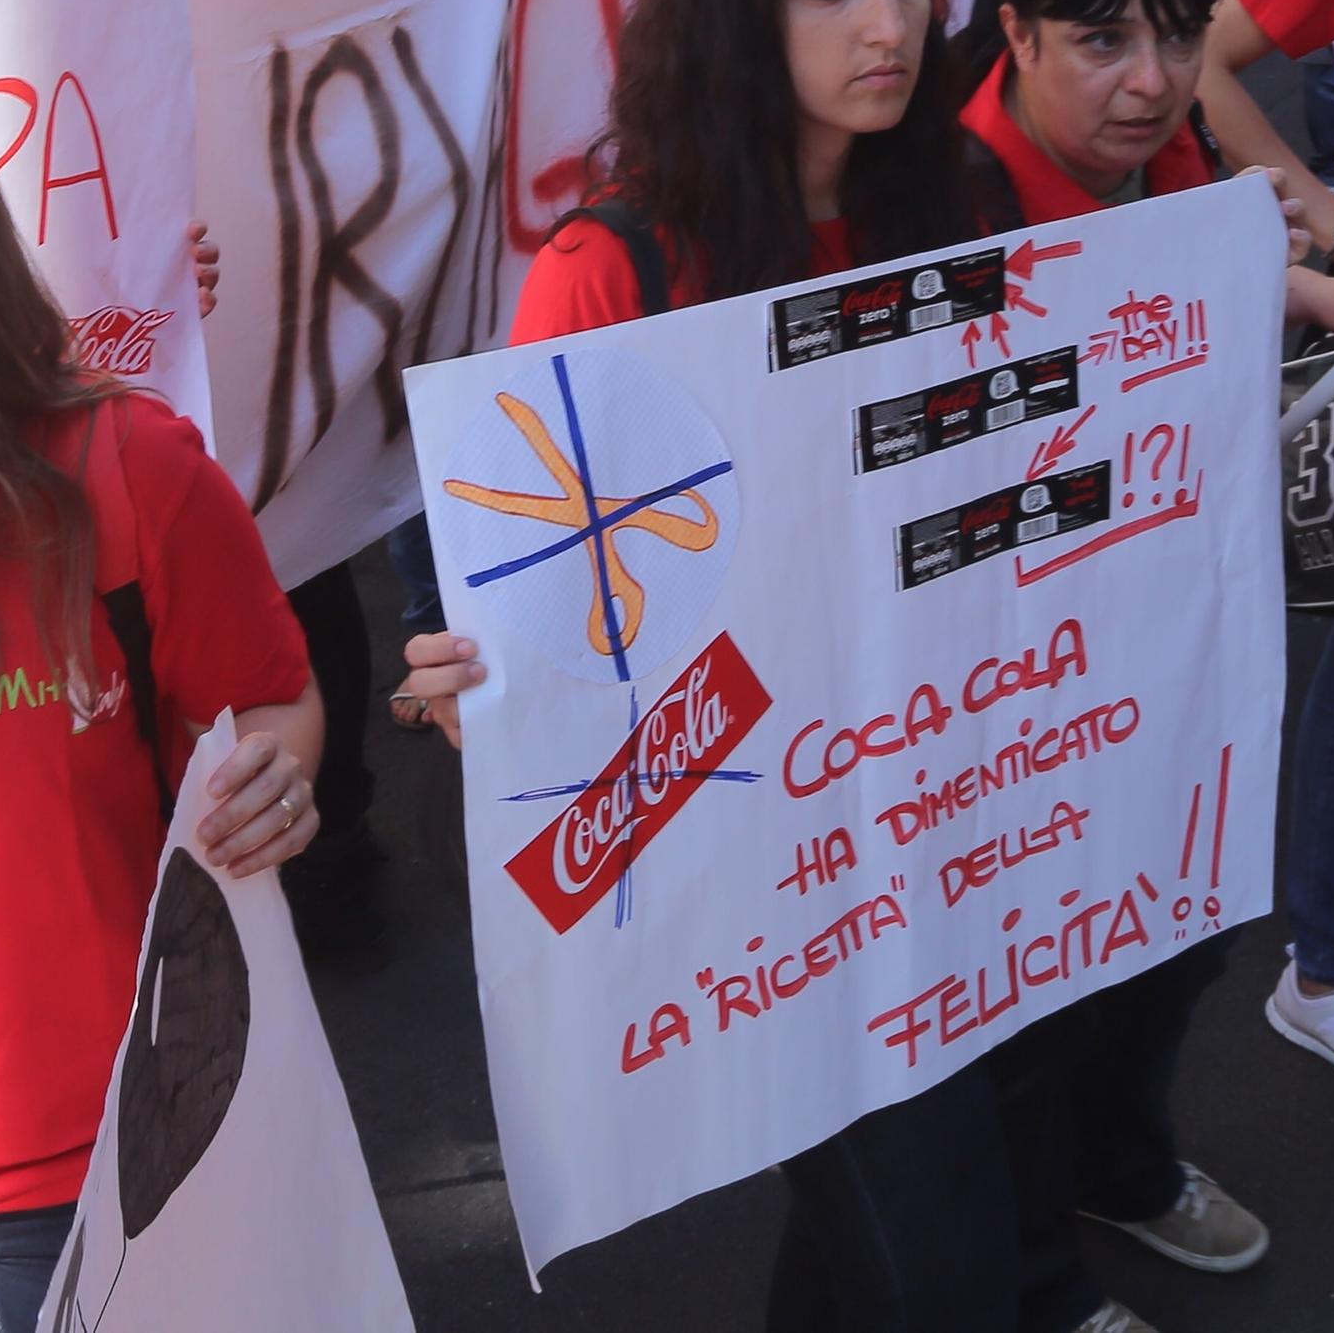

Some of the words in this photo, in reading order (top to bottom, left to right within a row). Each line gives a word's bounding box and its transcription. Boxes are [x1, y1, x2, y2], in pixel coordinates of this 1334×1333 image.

[782, 683, 953, 799] COCA
[963, 618, 1087, 714] COLA
[621, 1003, 691, 1075] LA
[939, 801, 1090, 909] DELLA
